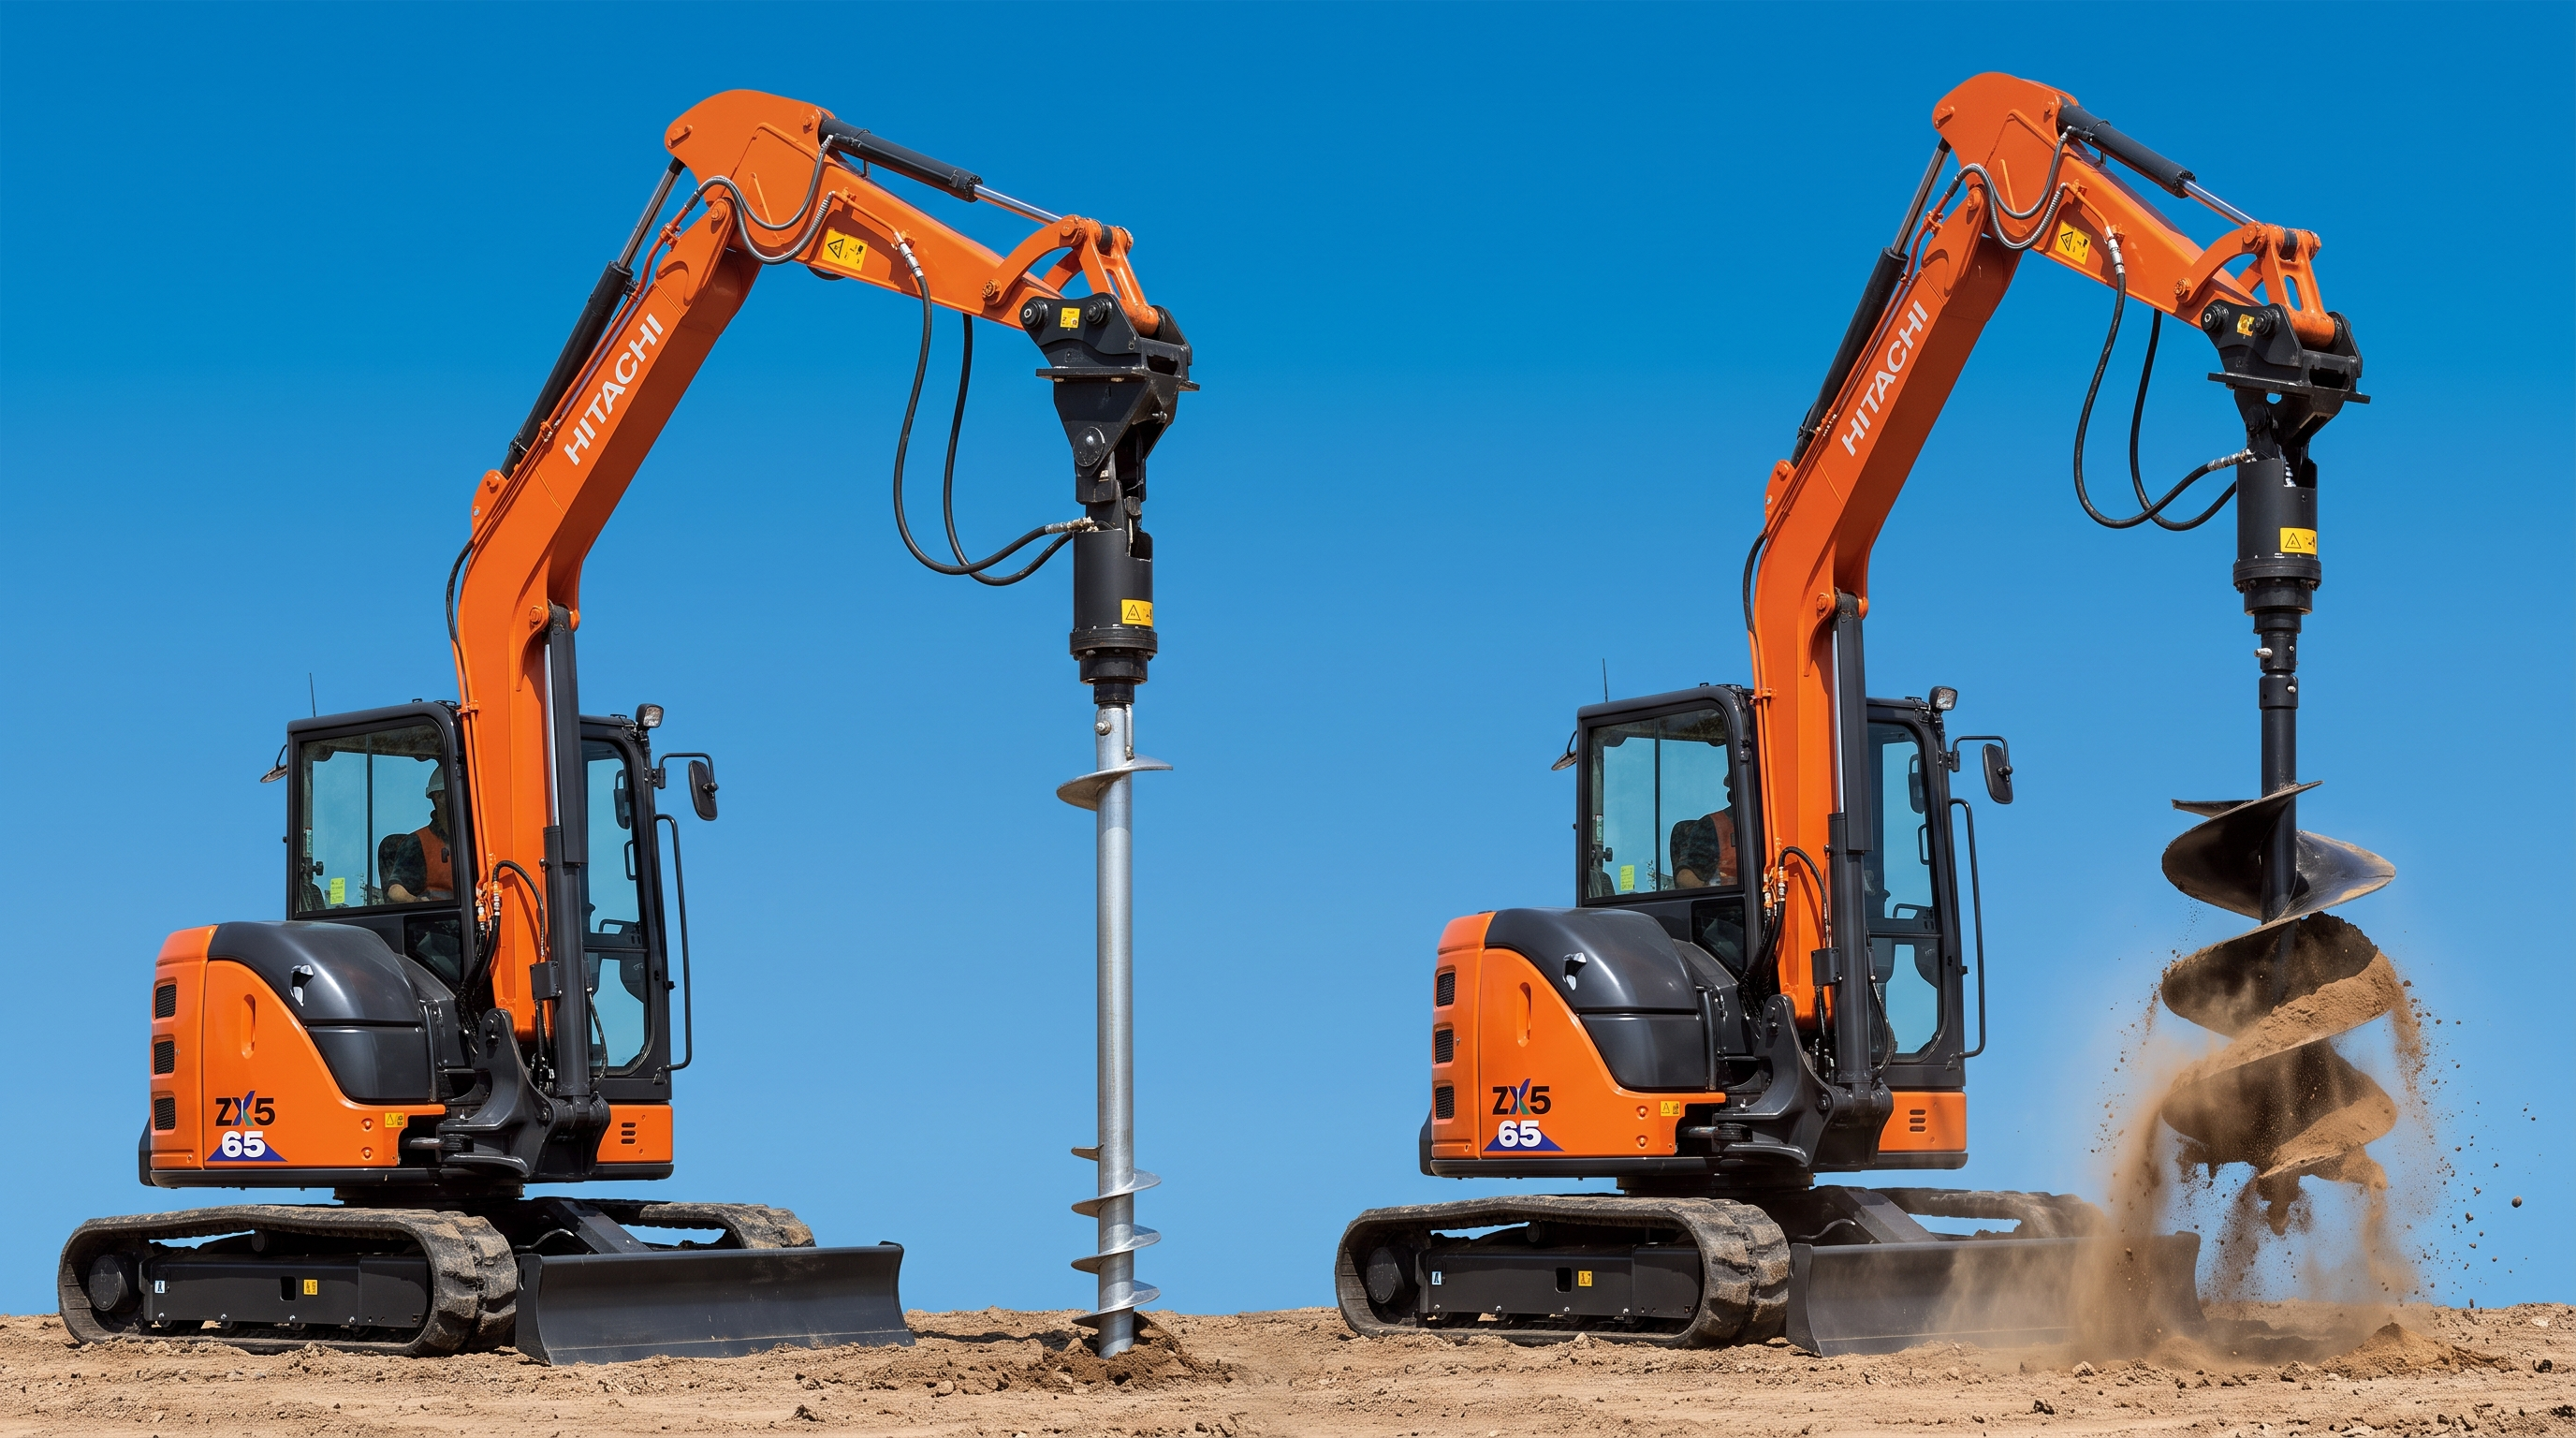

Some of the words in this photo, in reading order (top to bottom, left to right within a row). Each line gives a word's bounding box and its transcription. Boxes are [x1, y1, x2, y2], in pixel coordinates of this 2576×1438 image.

[564, 313, 664, 466] HITACHI
[1841, 300, 1928, 457] HITACHI
[215, 1090, 276, 1127] ZX5
[1492, 1078, 1552, 1116] ZX5
[221, 1130, 266, 1158] 65
[1498, 1120, 1542, 1148] 65
